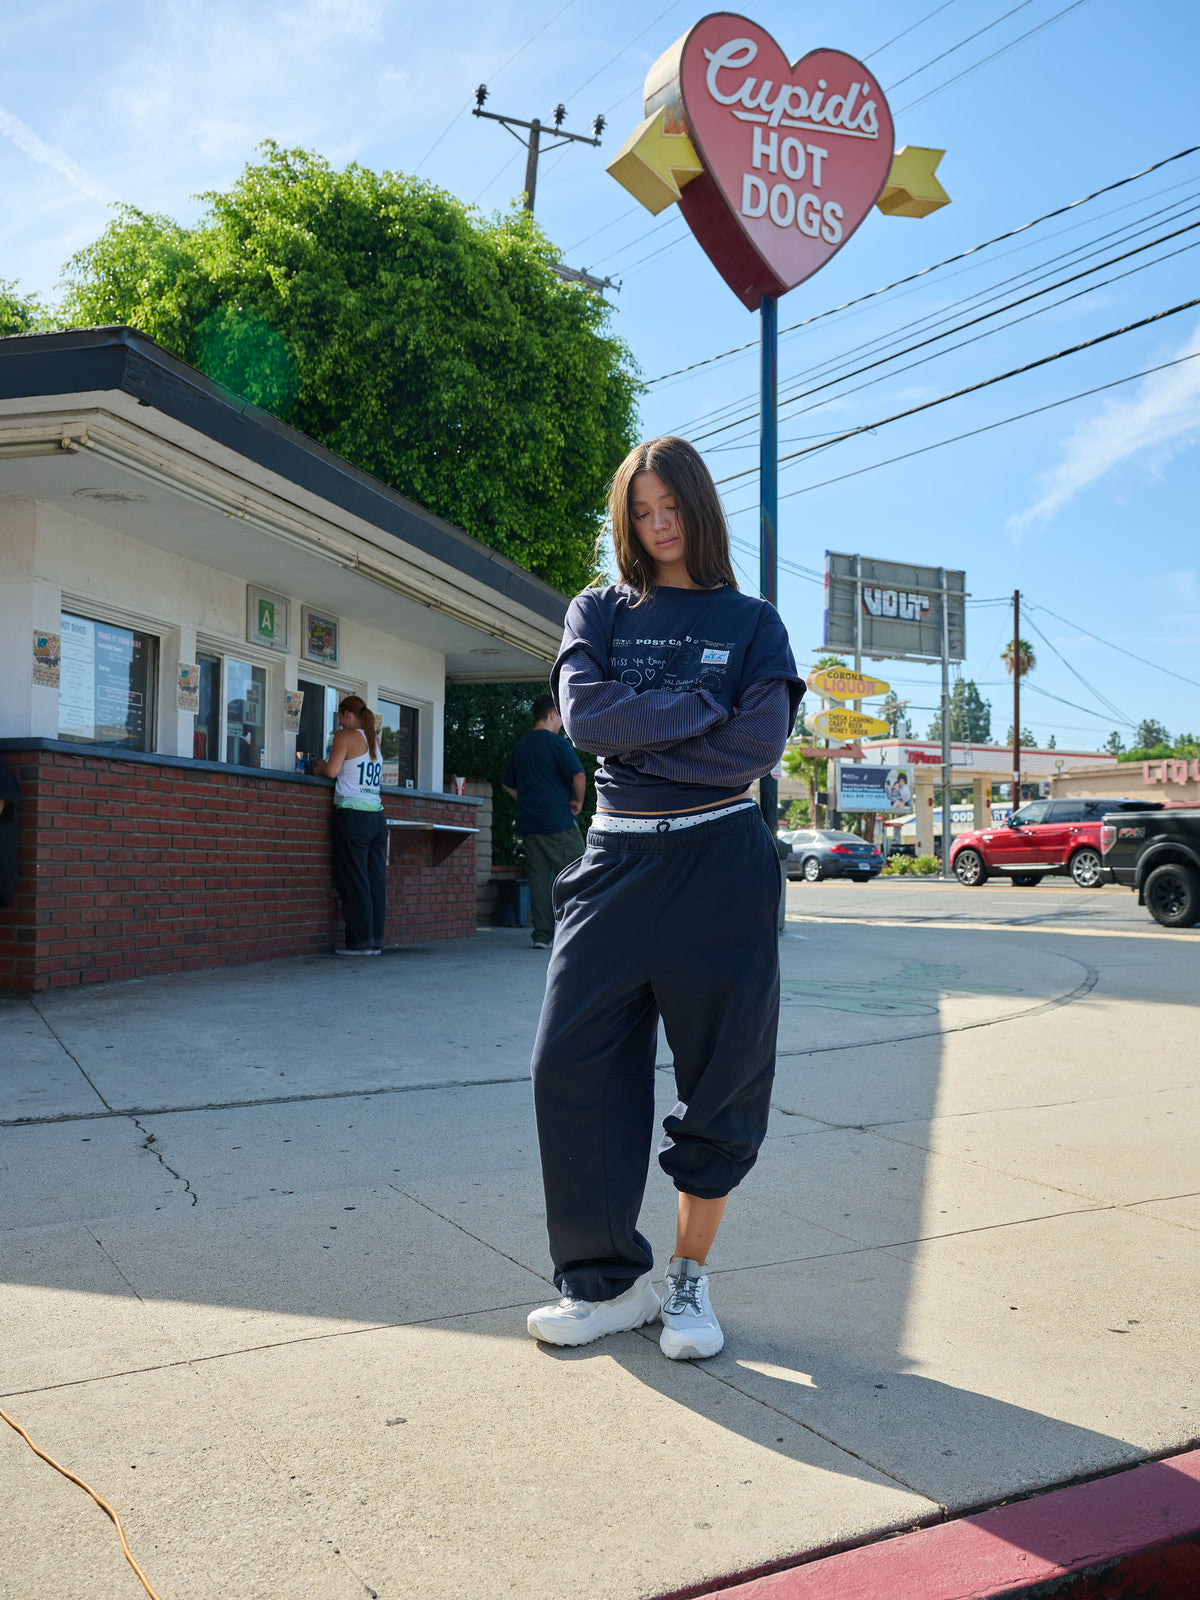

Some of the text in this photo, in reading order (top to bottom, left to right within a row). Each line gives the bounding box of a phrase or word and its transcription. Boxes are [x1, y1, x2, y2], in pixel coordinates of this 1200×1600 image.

[703, 38, 879, 136] Cupid's
[752, 126, 829, 188] HOT
[741, 173, 844, 245] DOGS
[861, 586, 931, 622] VOLT
[71, 623, 87, 635] DOGS
[262, 609, 272, 630] A
[635, 638, 667, 647] POST
[668, 636, 692, 648] CAD
[827, 671, 863, 681] CORONA
[823, 678, 876, 695] LIQUOR
[829, 720, 847, 728] CRAFT
[357, 761, 382, 788] 198
[951, 811, 975, 823] OOD
